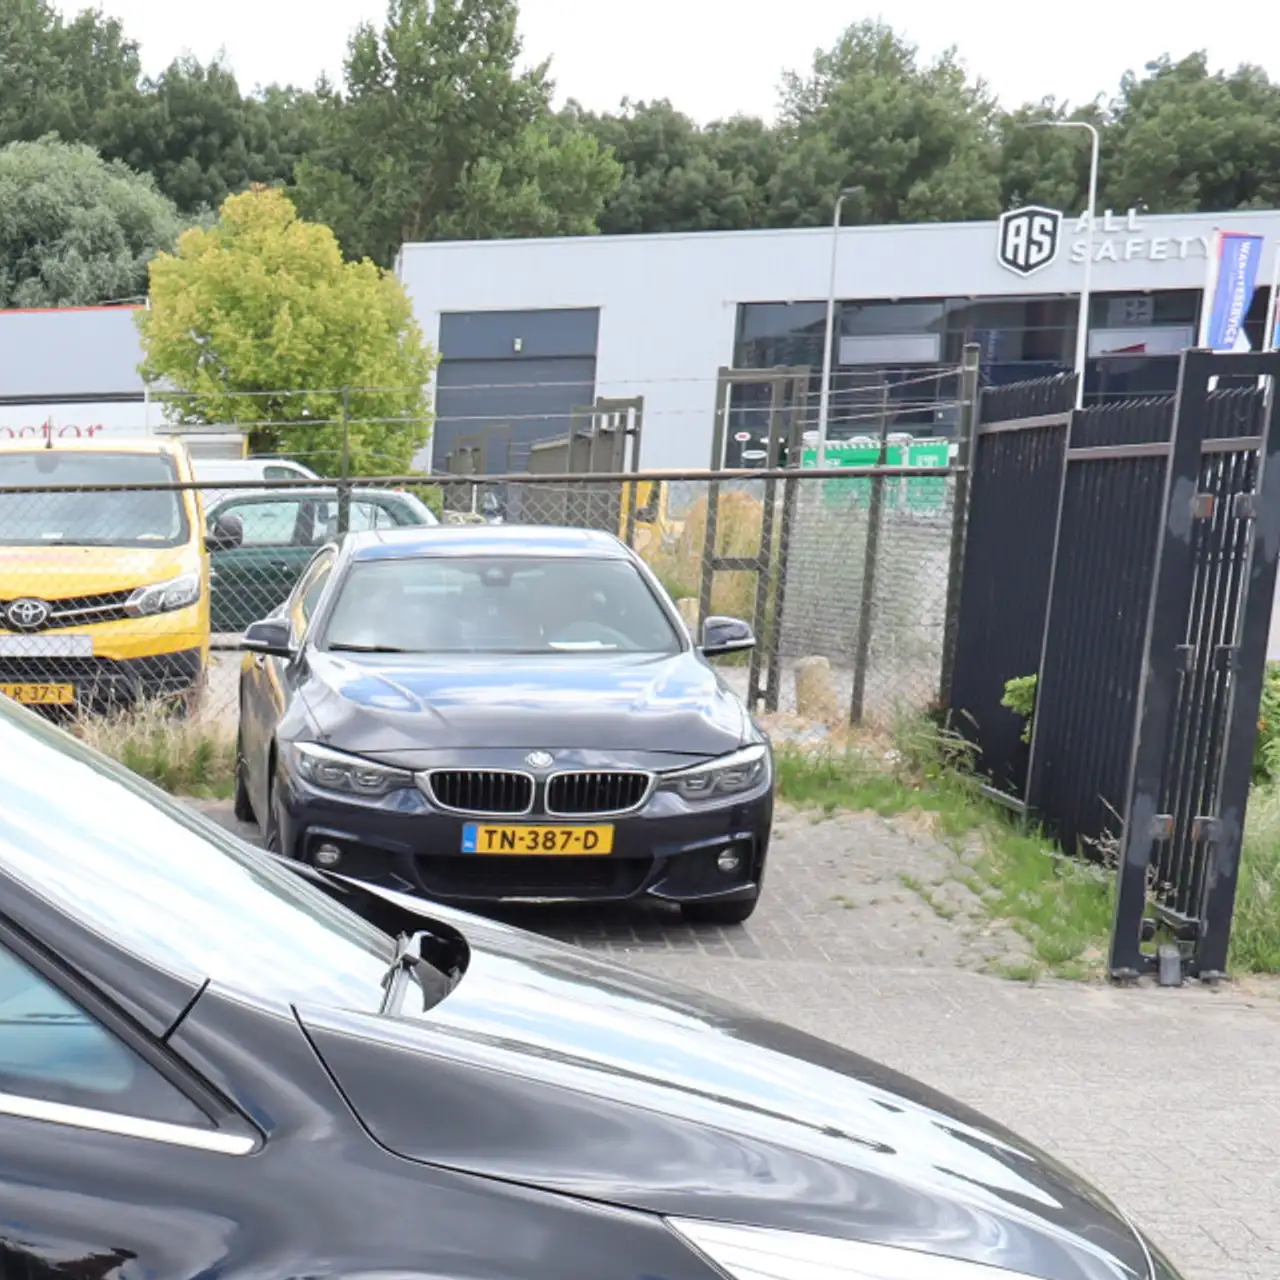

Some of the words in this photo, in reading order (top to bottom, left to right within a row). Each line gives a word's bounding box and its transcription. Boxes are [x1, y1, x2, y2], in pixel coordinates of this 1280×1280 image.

[1074, 208, 1143, 231] ALL
[1006, 216, 1053, 267] AS
[1071, 237, 1209, 262] SAFETY
[485, 829, 599, 850] TN-387-D
